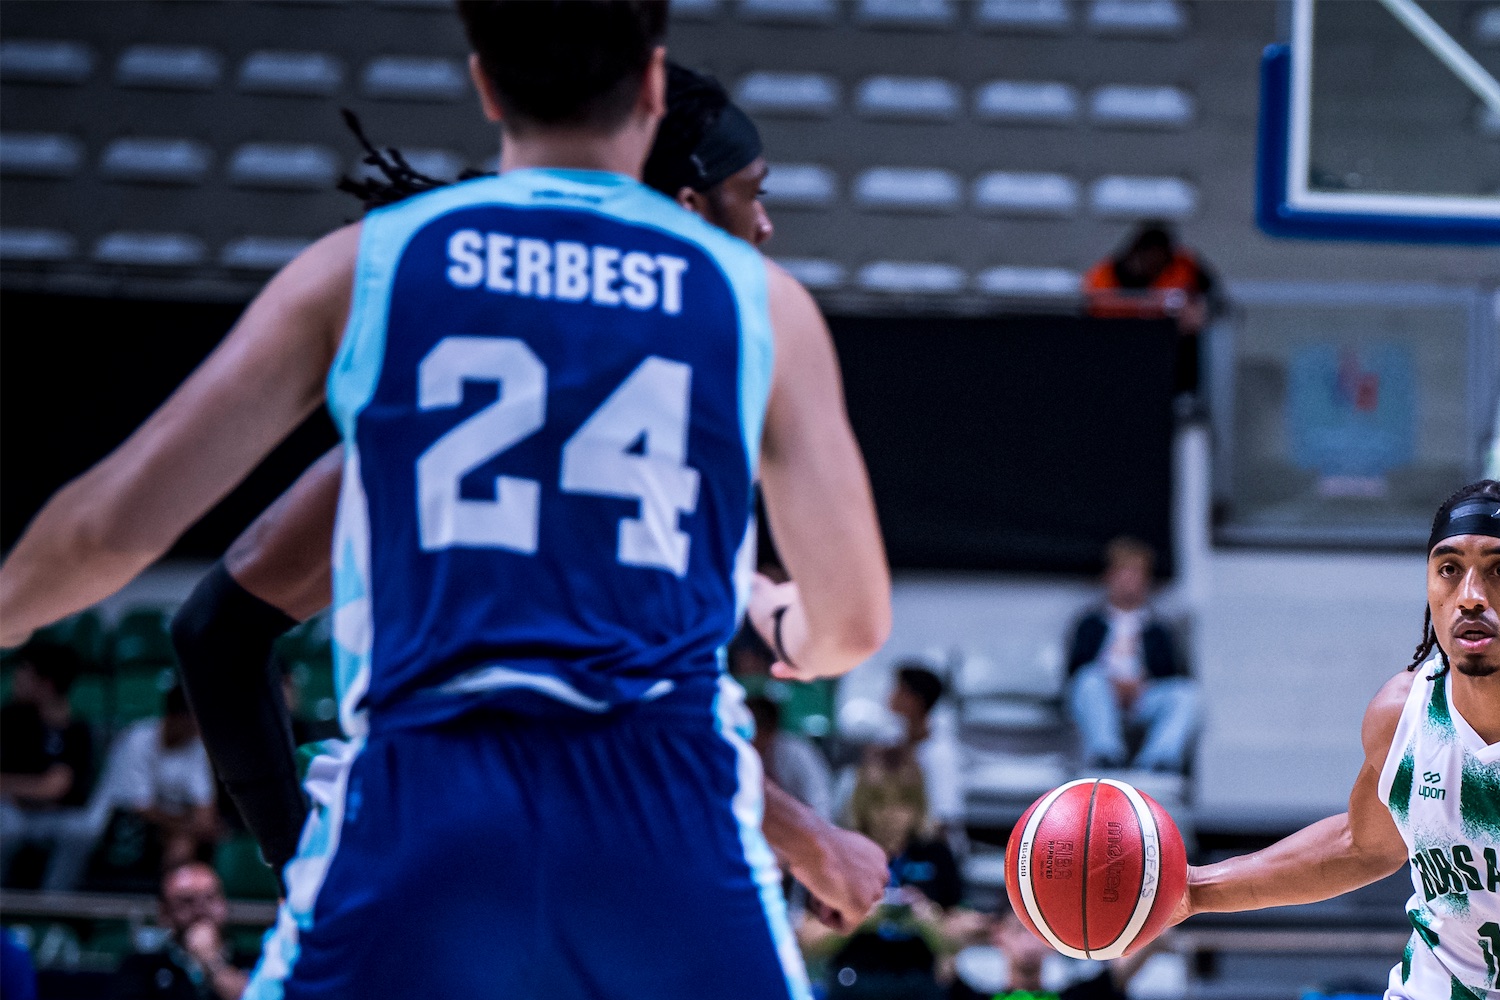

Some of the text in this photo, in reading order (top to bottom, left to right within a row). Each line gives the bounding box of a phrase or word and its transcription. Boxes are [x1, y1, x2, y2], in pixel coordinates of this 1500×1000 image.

[446, 229, 689, 315] SERBEST
[417, 336, 700, 577] 24
[1418, 784, 1445, 801] upon
[1047, 841, 1055, 880] APPROVED
[1055, 840, 1073, 880] FIBA
[1103, 821, 1124, 903] molten
